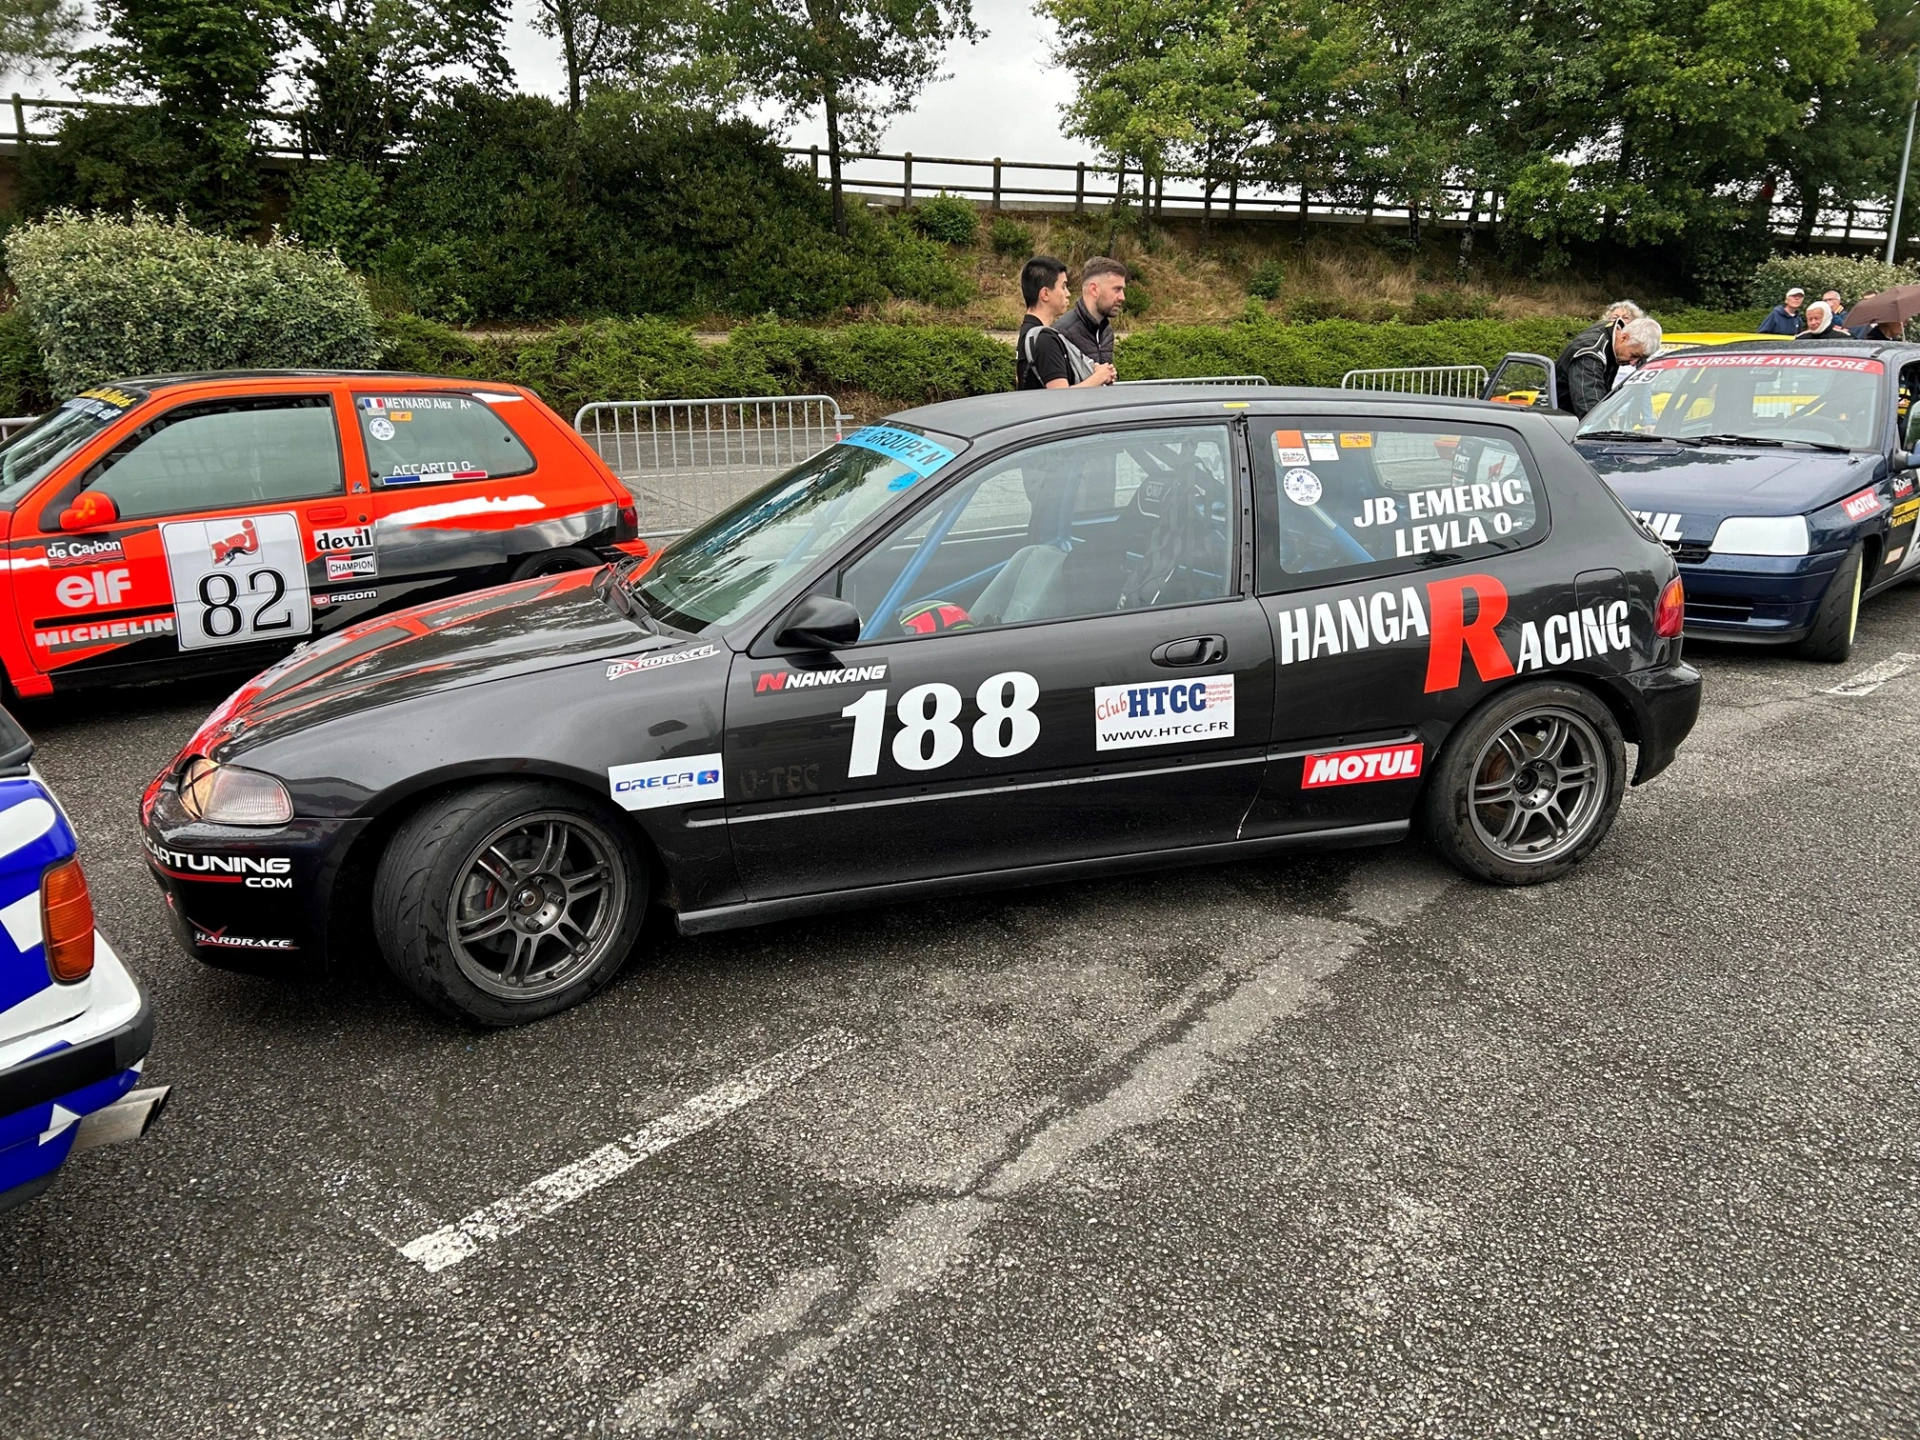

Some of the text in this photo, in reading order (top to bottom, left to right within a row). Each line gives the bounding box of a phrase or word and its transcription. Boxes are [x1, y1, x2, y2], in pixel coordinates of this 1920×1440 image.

[1676, 356, 1764, 368] TOURISME
[1765, 356, 1870, 371] AMÉLIORÉ
[1629, 370, 1660, 382] 49
[384, 398, 472, 410] MEYNARD Alex A+
[866, 431, 932, 459] GROUPE
[917, 453, 946, 466] N
[393, 462, 445, 475] ACCART
[1353, 479, 1525, 528] JB EMERIC
[1846, 492, 1880, 517] MOTUL
[47, 539, 121, 559] de Carbon
[316, 527, 372, 550] devil
[1395, 522, 1488, 557] LEVLA
[330, 561, 373, 573] CHAMPION
[56, 569, 131, 608] elf
[331, 590, 377, 603] FACOM
[197, 568, 294, 638] 82
[35, 618, 173, 646] MICHELIN
[606, 645, 714, 677] HARDRACE
[785, 665, 887, 690] NANKANG
[1097, 683, 1206, 720] Club HTCC
[842, 671, 1041, 779] 188
[1102, 721, 1229, 743] WWW.HTCC.FR
[1308, 750, 1417, 784] MOTUL
[615, 772, 693, 793] ORECA
[245, 877, 293, 889] COM
[196, 931, 292, 948] HARDRACE
